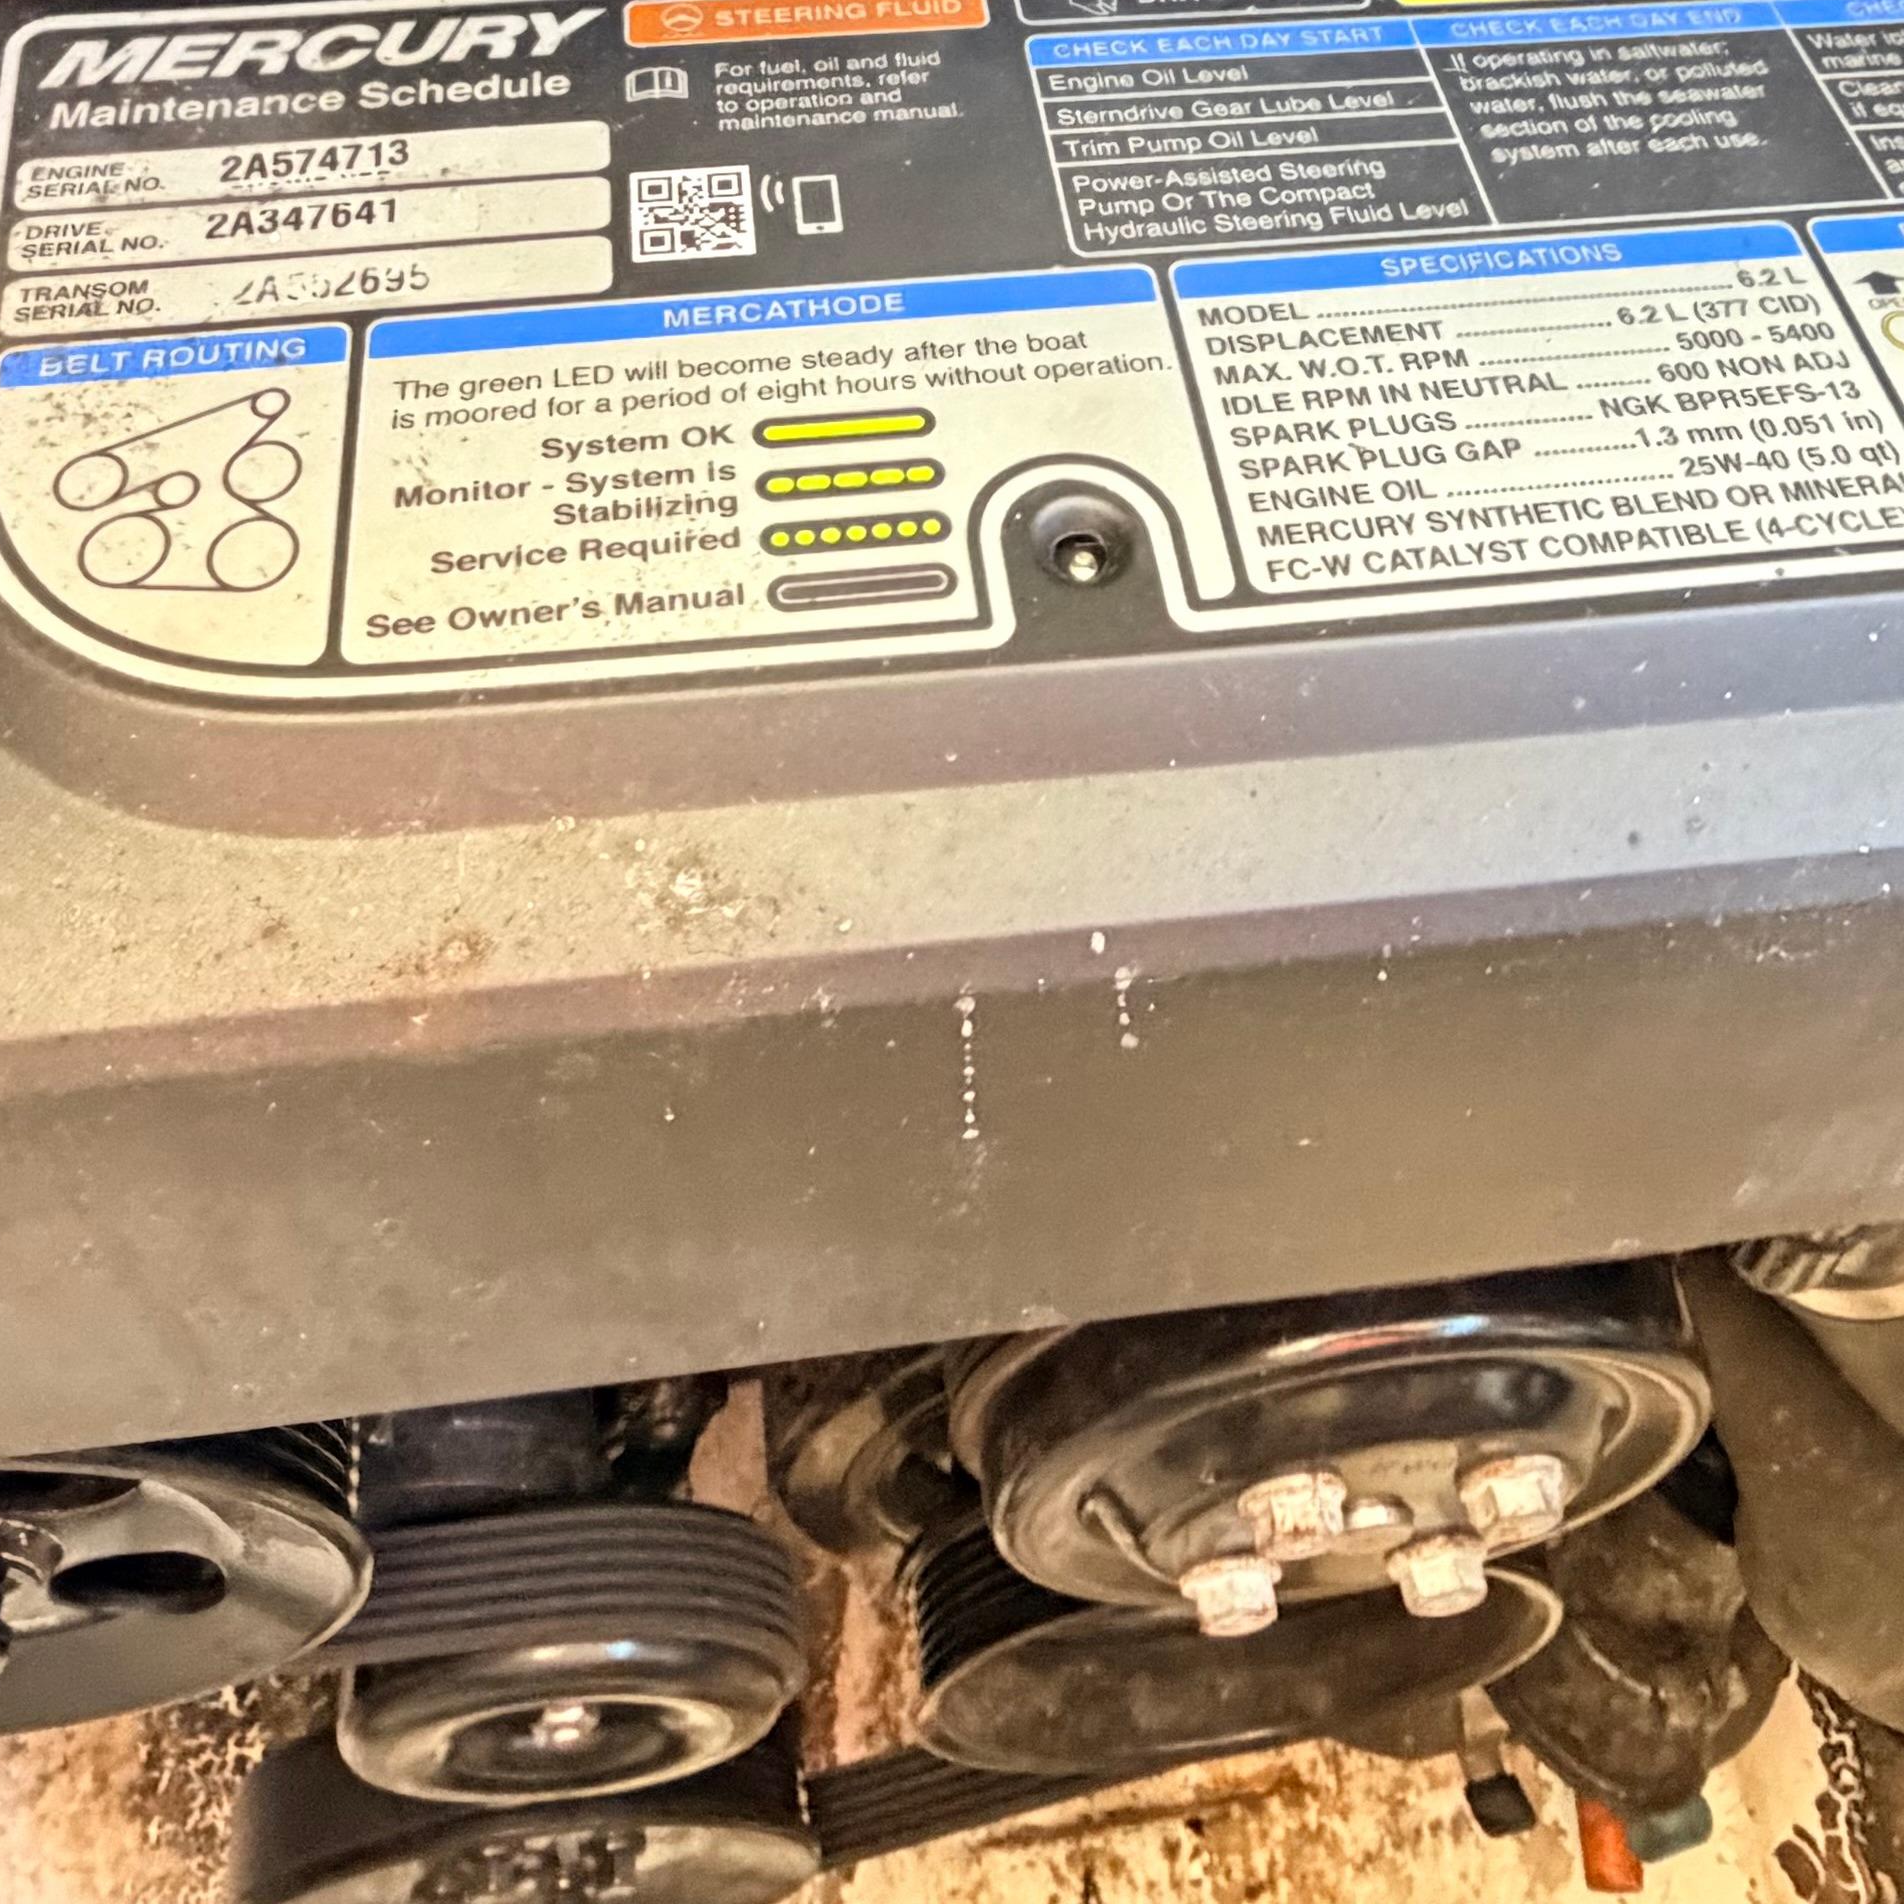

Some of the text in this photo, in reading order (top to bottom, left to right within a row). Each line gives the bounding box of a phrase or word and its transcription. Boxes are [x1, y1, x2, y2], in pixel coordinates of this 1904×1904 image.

[715, 2, 866, 26] STEERING
[39, 7, 607, 90] MERCURY
[1053, 25, 1381, 58] CHECK EACH DAY START
[1048, 64, 1248, 92] Engine Oil Level
[49, 72, 571, 129] Maintenance Schedule
[718, 102, 963, 131] maintenance manual.
[1056, 90, 1394, 125] Sterndrive Gear Lube Level
[1061, 126, 1318, 157] Trim Pump Oil Level
[27, 139, 410, 198] SERIAL NO. 2A574713
[30, 162, 124, 181] ENGINE
[1071, 158, 1385, 193] Power-Assisted Steering
[1077, 182, 1375, 216] Pump Or The Compact
[1083, 198, 1469, 243] Hydraulic Steering Fluid Level
[20, 198, 398, 258] SERIAL NO. 2A347641
[25, 221, 102, 240] DRIVE
[1380, 243, 1623, 279] SPECIFICATIONS
[14, 300, 109, 322] SERIAL
[115, 297, 160, 315] NO.
[20, 279, 148, 302] TRANSOM
[663, 292, 904, 328] MERCATHODE
[1197, 266, 1807, 326] MODEL 6.2 L
[1204, 293, 1820, 355] DISPLACEMENT 6.2 L (377 CID)
[38, 336, 305, 377] BELT ROUTING
[392, 330, 1087, 401] The green LED will become steady after the boat
[1213, 361, 1292, 385] MAX.
[1298, 353, 1393, 378] W.O.T.
[1399, 348, 1469, 371] RPM
[1675, 327, 1743, 350] 5000
[1767, 321, 1834, 343] 5400
[391, 354, 1171, 429] is moored for a period of eight hours without operation.
[1221, 351, 1850, 415] IDLE RPM IN NEUTRAL 600 NON ADJ
[1229, 379, 1860, 447] SPARK PLUGS NGK BPR5EFS-13
[540, 423, 734, 462] System OK
[1238, 409, 1883, 479] SPARK PLUG GAP 1.3 mm (0.051 in)
[394, 480, 531, 508] Monitor
[565, 467, 694, 497] System
[1247, 439, 1899, 512] ENGINE OIL 25W-40 (5.0 qt)
[552, 493, 737, 525] Stabilizing
[1257, 512, 1414, 547] MERCURY
[1426, 498, 1604, 534] SYNTHETIC
[1610, 488, 1718, 516] BLEND
[1725, 484, 1774, 507] OR
[430, 525, 740, 573] Service Required
[1266, 553, 1350, 582] FC-W
[1362, 538, 1528, 573] CATALYST
[1539, 519, 1750, 559] COMPATIBLE
[366, 582, 744, 638] See Owner's Manual
